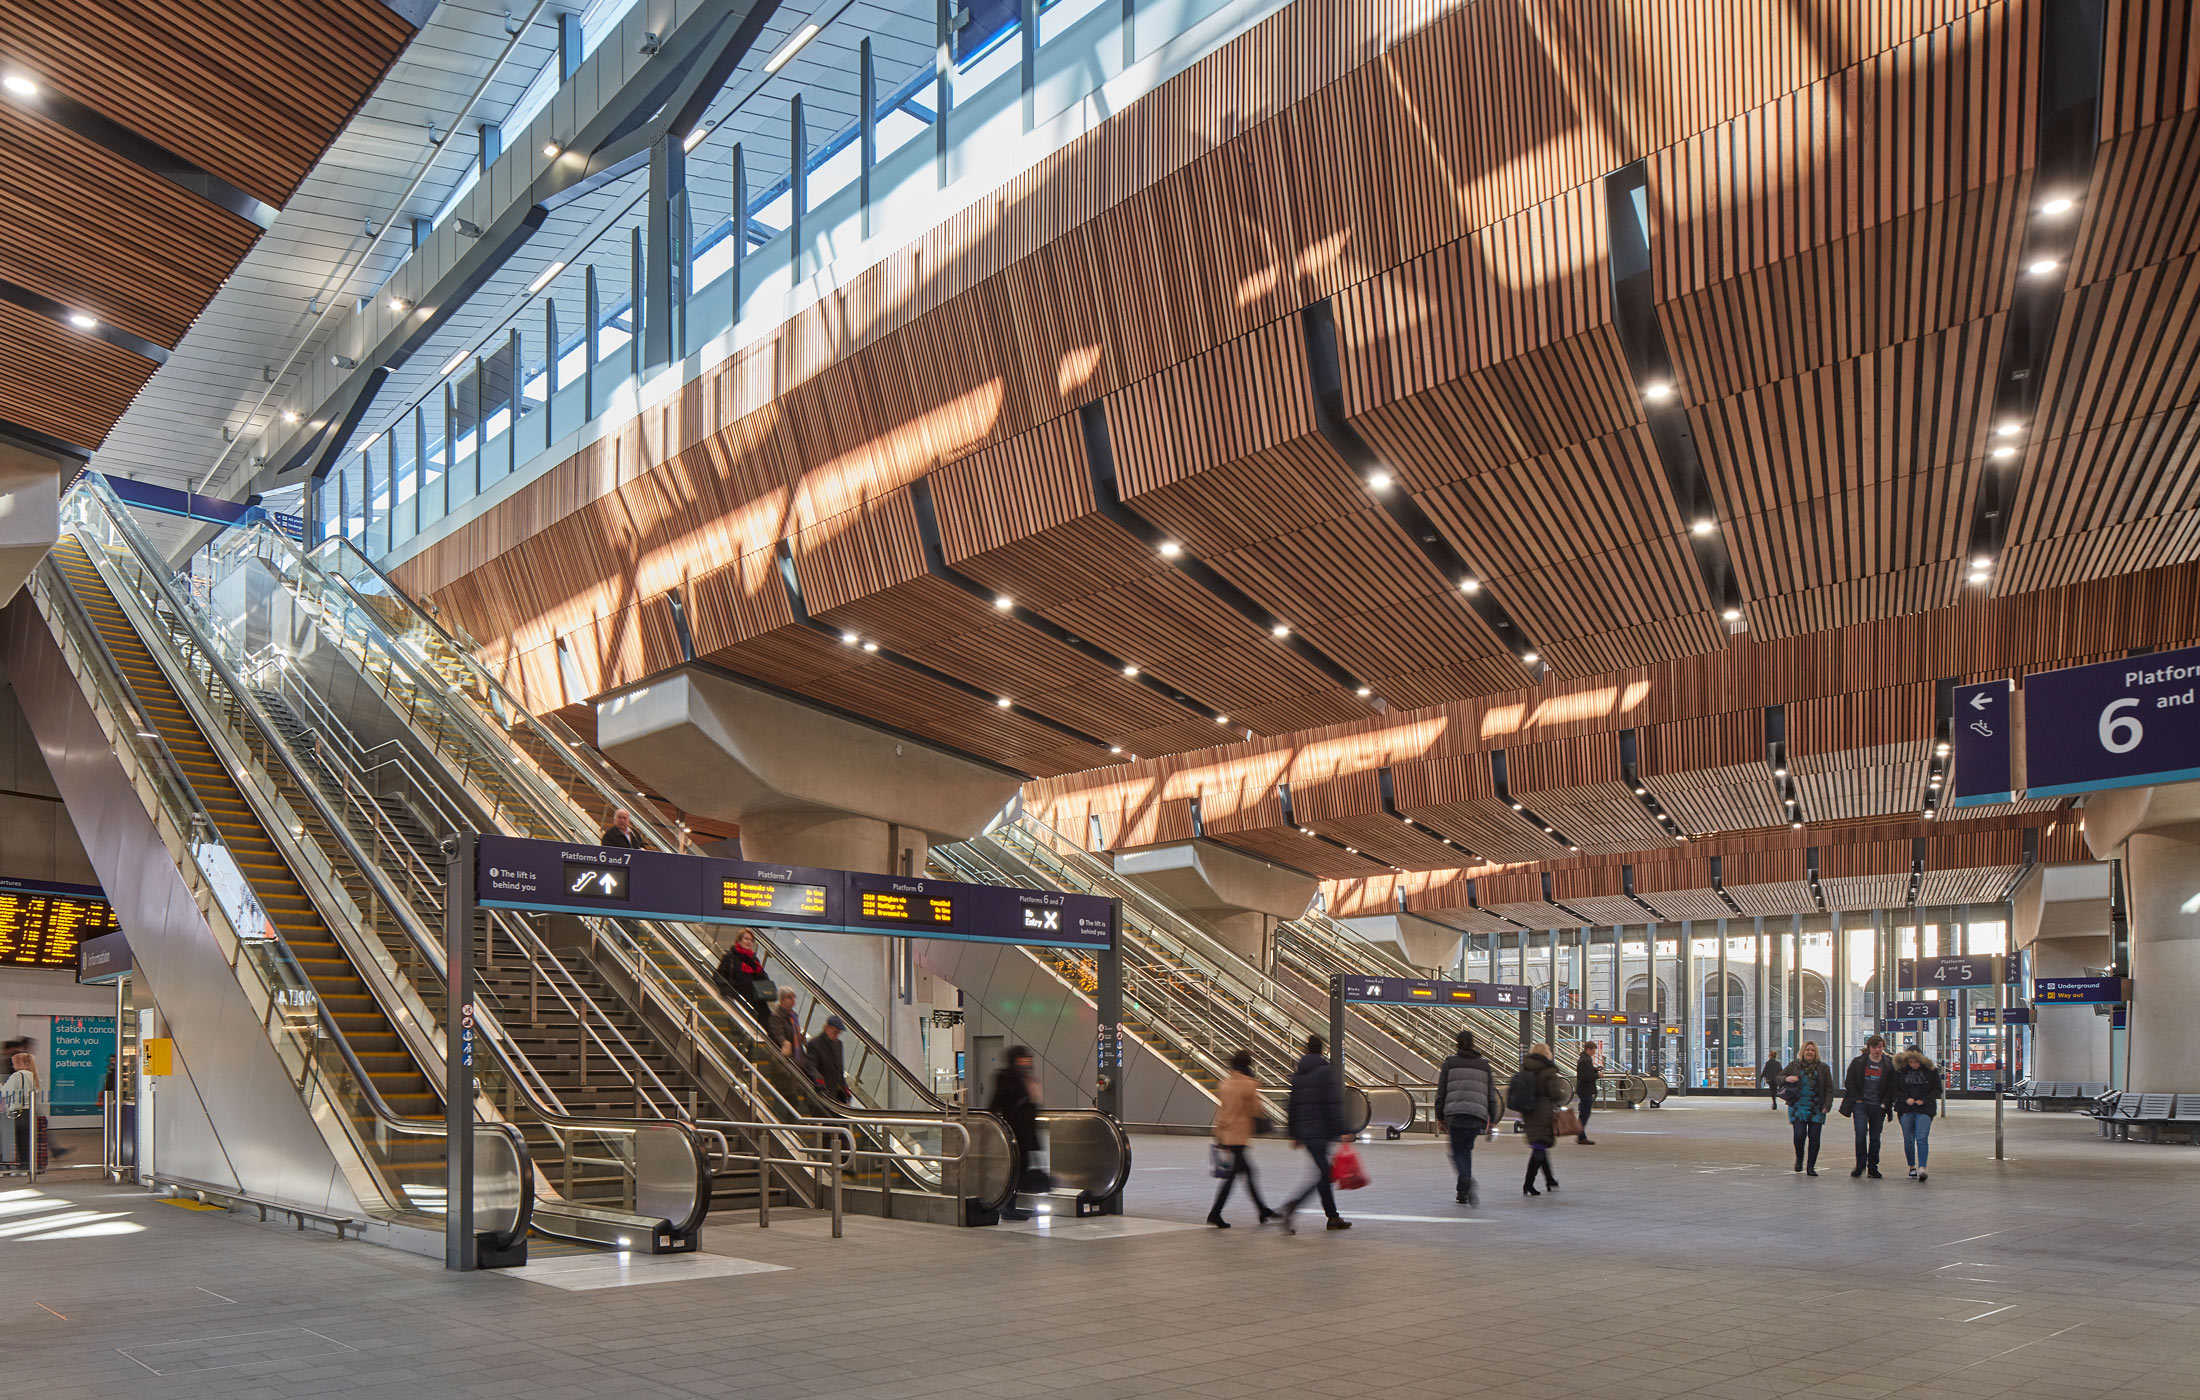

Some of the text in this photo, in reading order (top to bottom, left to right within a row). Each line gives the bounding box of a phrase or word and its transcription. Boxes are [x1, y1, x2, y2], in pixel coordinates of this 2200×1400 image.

[2098, 688, 2194, 754] 6 and
[561, 851, 631, 865] Platforms 6 and 7
[500, 870, 536, 880] The lift is
[758, 870, 792, 880] Platform 7
[493, 880, 536, 892] behind you
[893, 883, 924, 892] Platform 6
[1019, 896, 1042, 904] Platforms
[1044, 895, 1048, 904] 6
[1059, 896, 1064, 905] 7
[1025, 909, 1033, 918] No
[1025, 918, 1042, 927] Entry
[1934, 967, 1946, 981] 4
[1961, 965, 1972, 980] 5
[2058, 982, 2100, 990] Underground
[1907, 1007, 1914, 1015] 2
[1922, 1006, 1929, 1015] 3
[56, 1036, 80, 1044] thank
[56, 1060, 93, 1068] patience.
